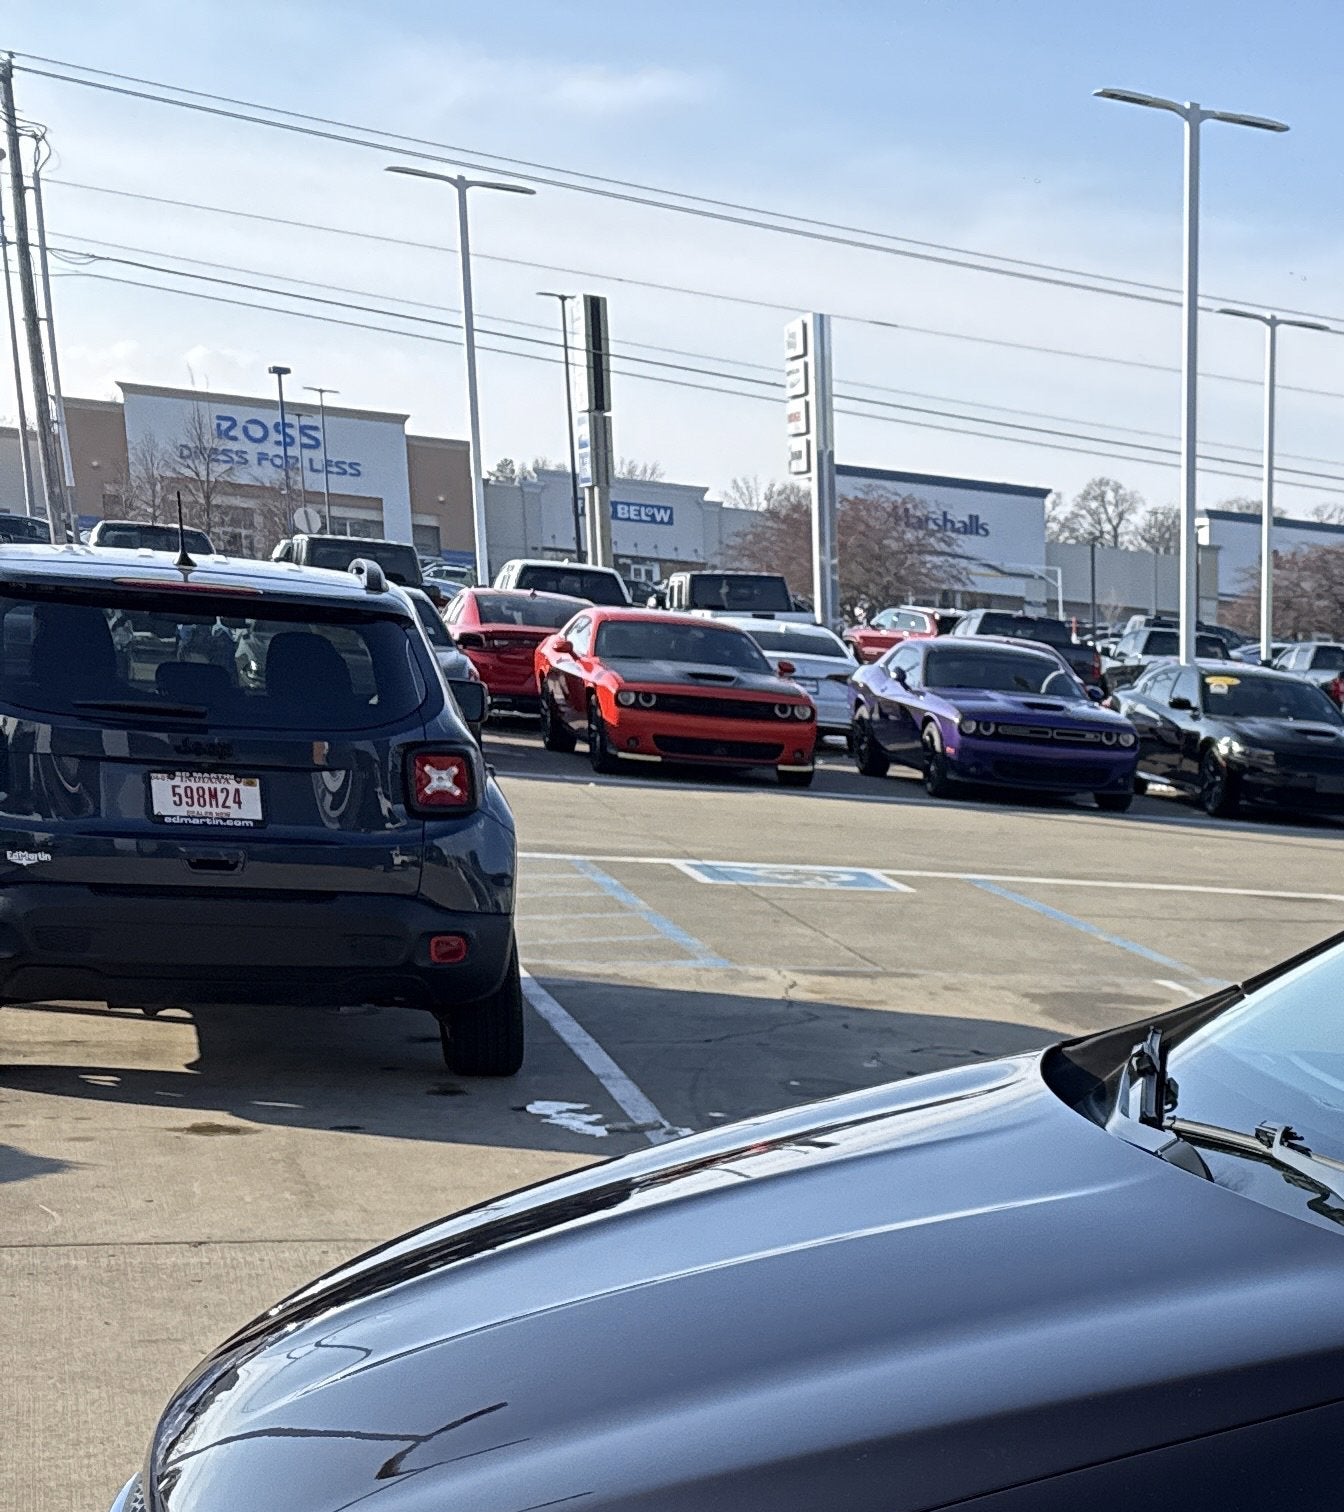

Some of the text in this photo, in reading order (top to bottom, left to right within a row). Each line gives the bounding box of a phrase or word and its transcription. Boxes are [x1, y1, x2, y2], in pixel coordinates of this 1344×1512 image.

[215, 415, 321, 449] ROSS
[616, 503, 671, 523] BELOW
[171, 785, 242, 809] 598M24
[164, 816, 253, 827] edmartin.com
